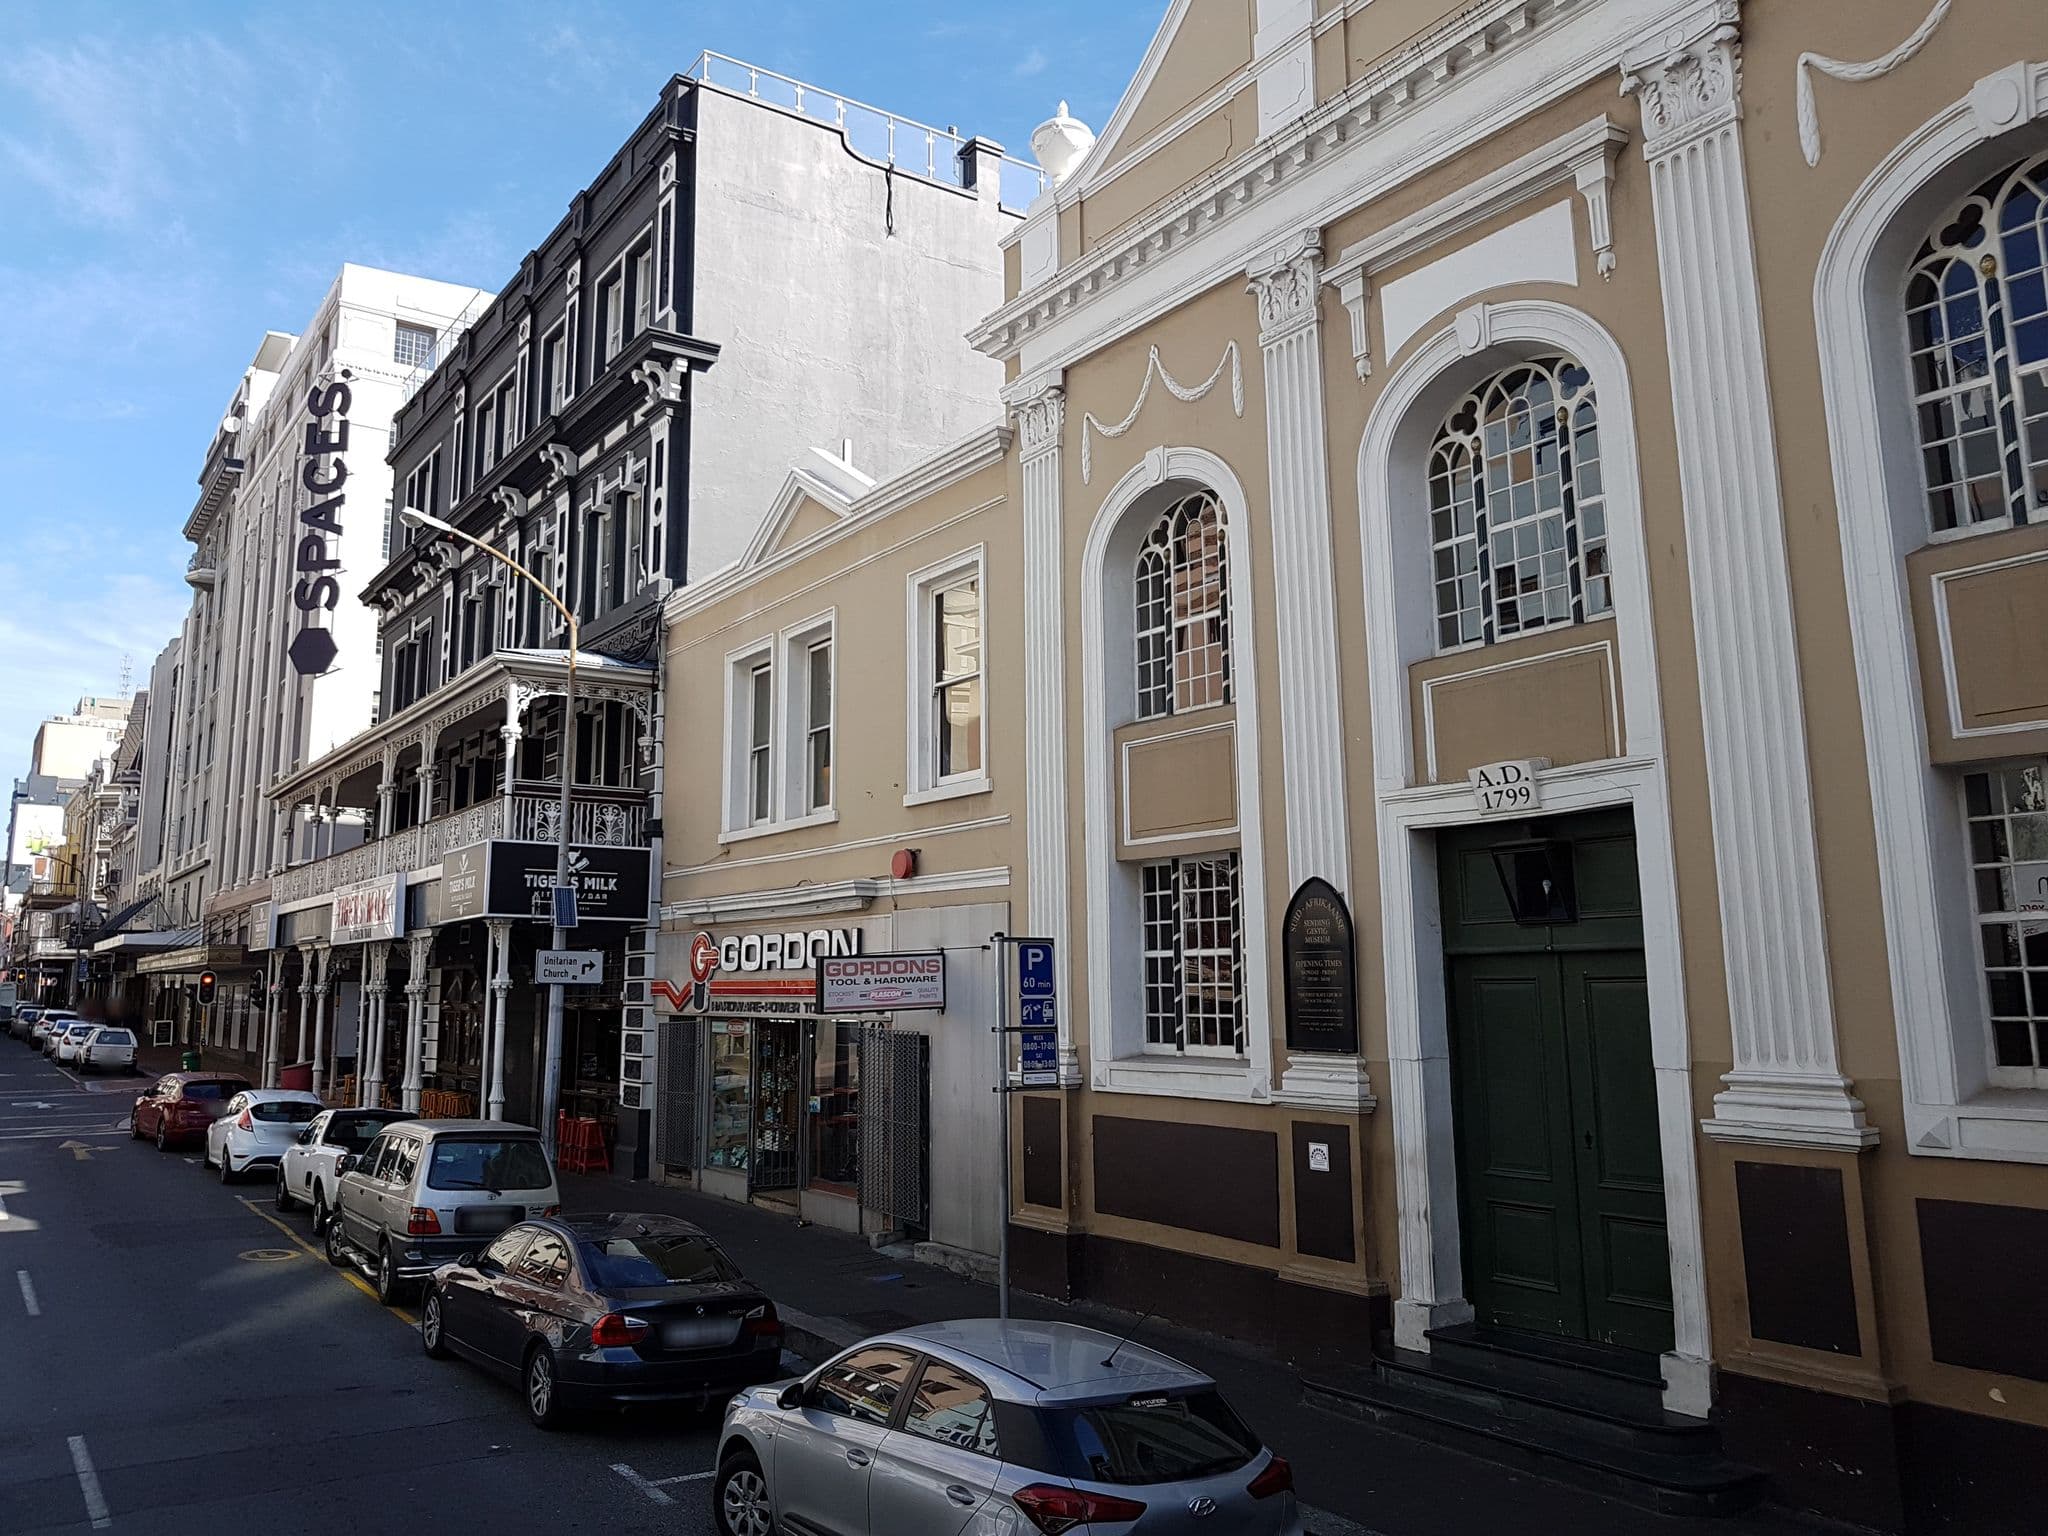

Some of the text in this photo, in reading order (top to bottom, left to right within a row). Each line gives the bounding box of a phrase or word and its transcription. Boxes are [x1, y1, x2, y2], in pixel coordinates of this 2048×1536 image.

[1477, 765, 1530, 789] A.D.
[1482, 786, 1531, 810] 1799
[524, 874, 618, 891] TIGE'S MILK
[544, 956, 578, 966] Unitarian
[825, 959, 941, 977] GORDONS
[1027, 949, 1044, 971] P
[543, 968, 569, 978] Church
[829, 975, 938, 986] TOOL & HARDWARE
[1023, 977, 1051, 989] 60 min
